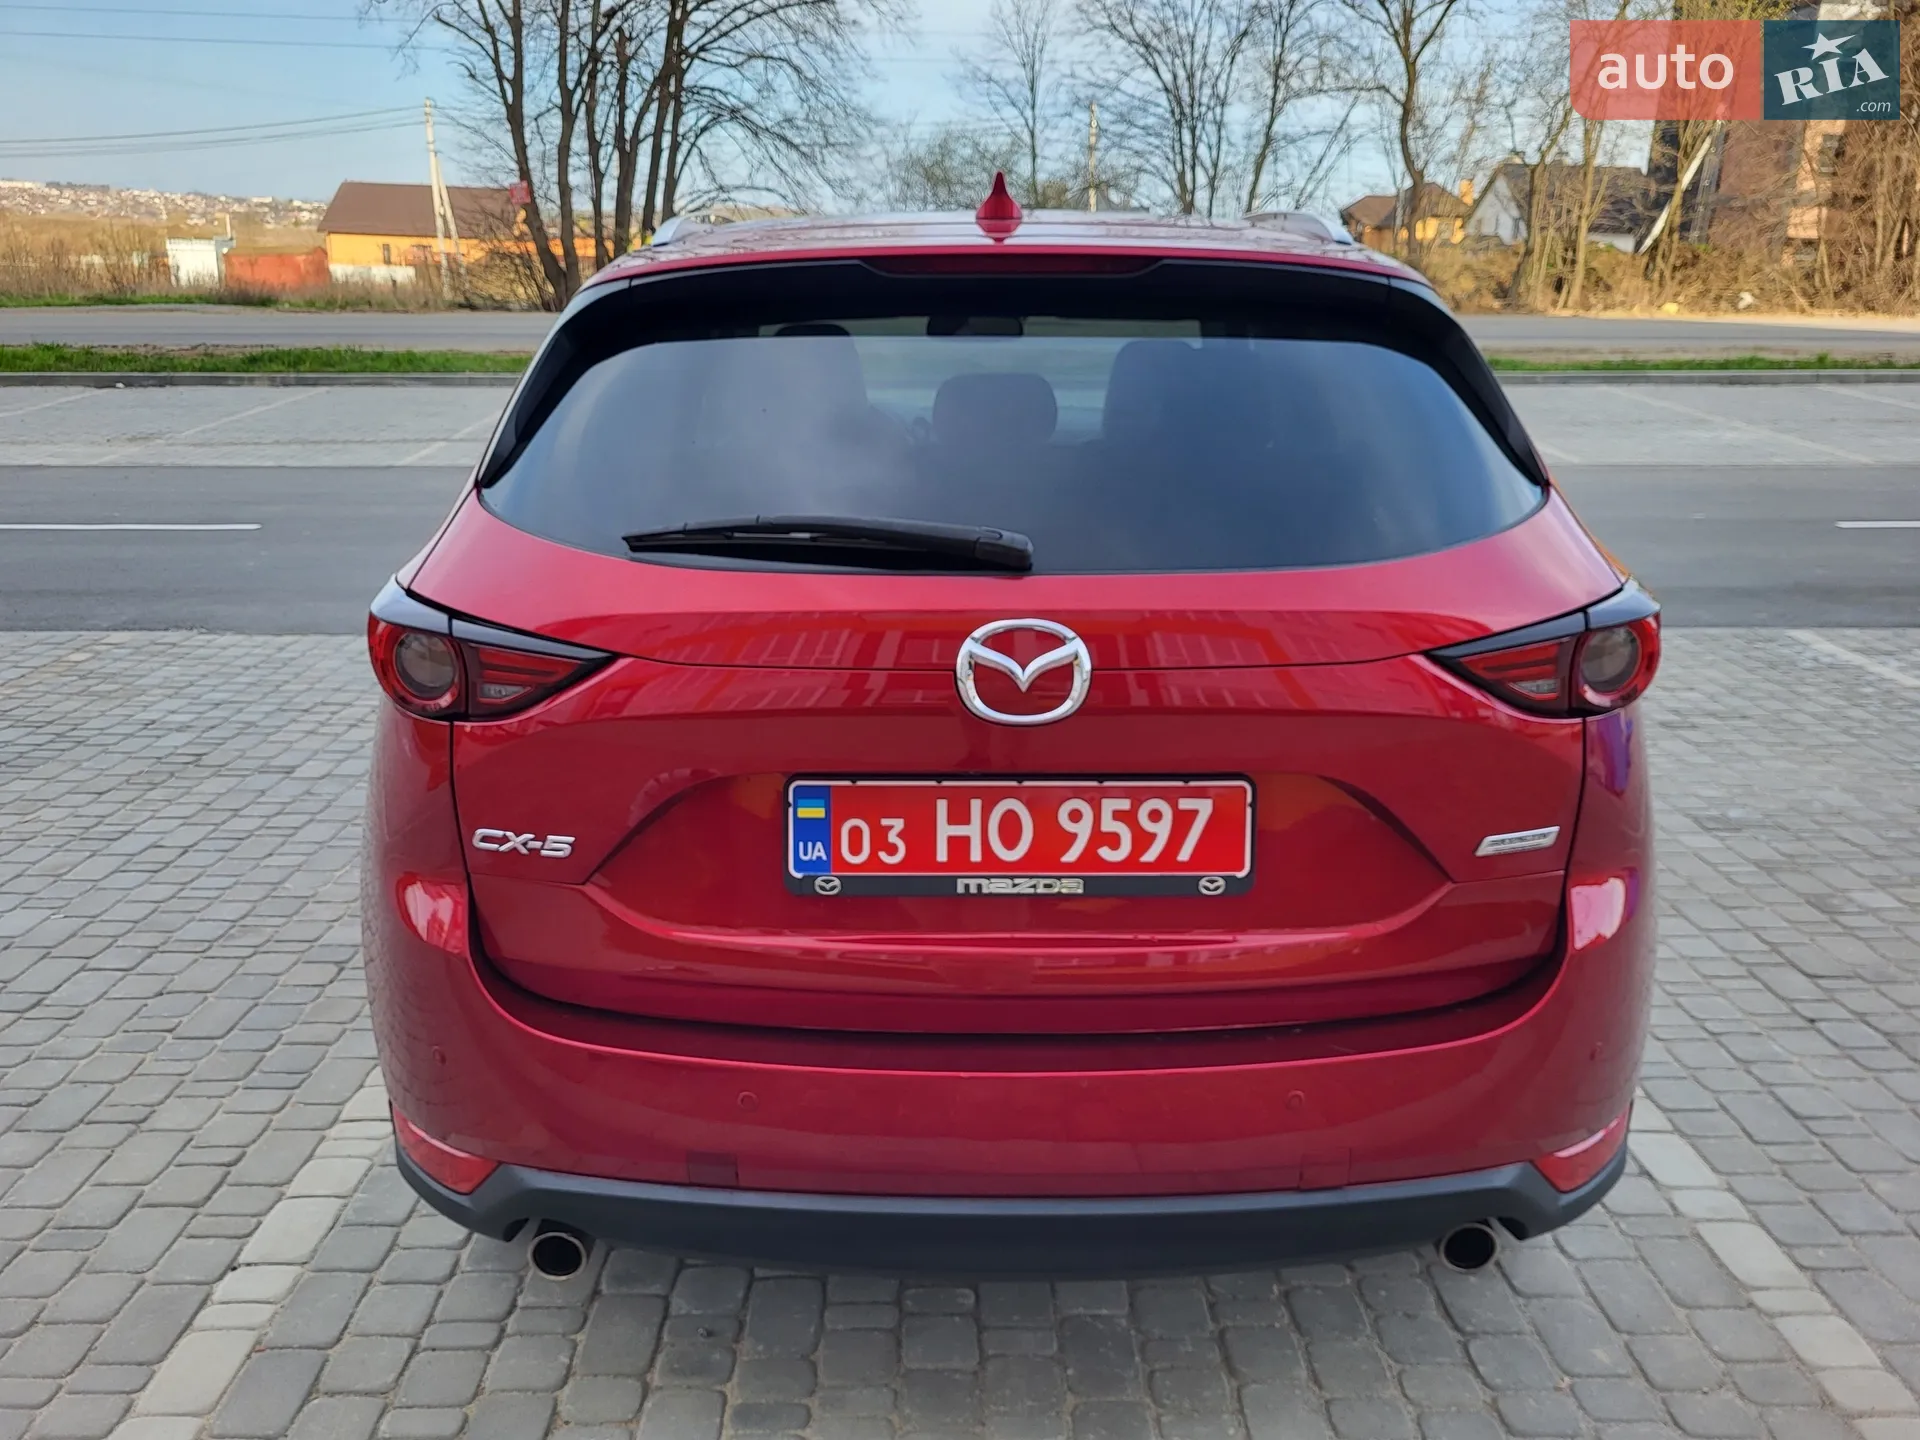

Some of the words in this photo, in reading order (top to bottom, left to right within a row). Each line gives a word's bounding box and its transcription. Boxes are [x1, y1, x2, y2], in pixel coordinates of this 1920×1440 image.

[472, 828, 576, 858] CX-5
[840, 818, 906, 865] 03
[935, 798, 1034, 863] HO
[1057, 797, 1213, 863] 9597
[798, 841, 827, 861] UA
